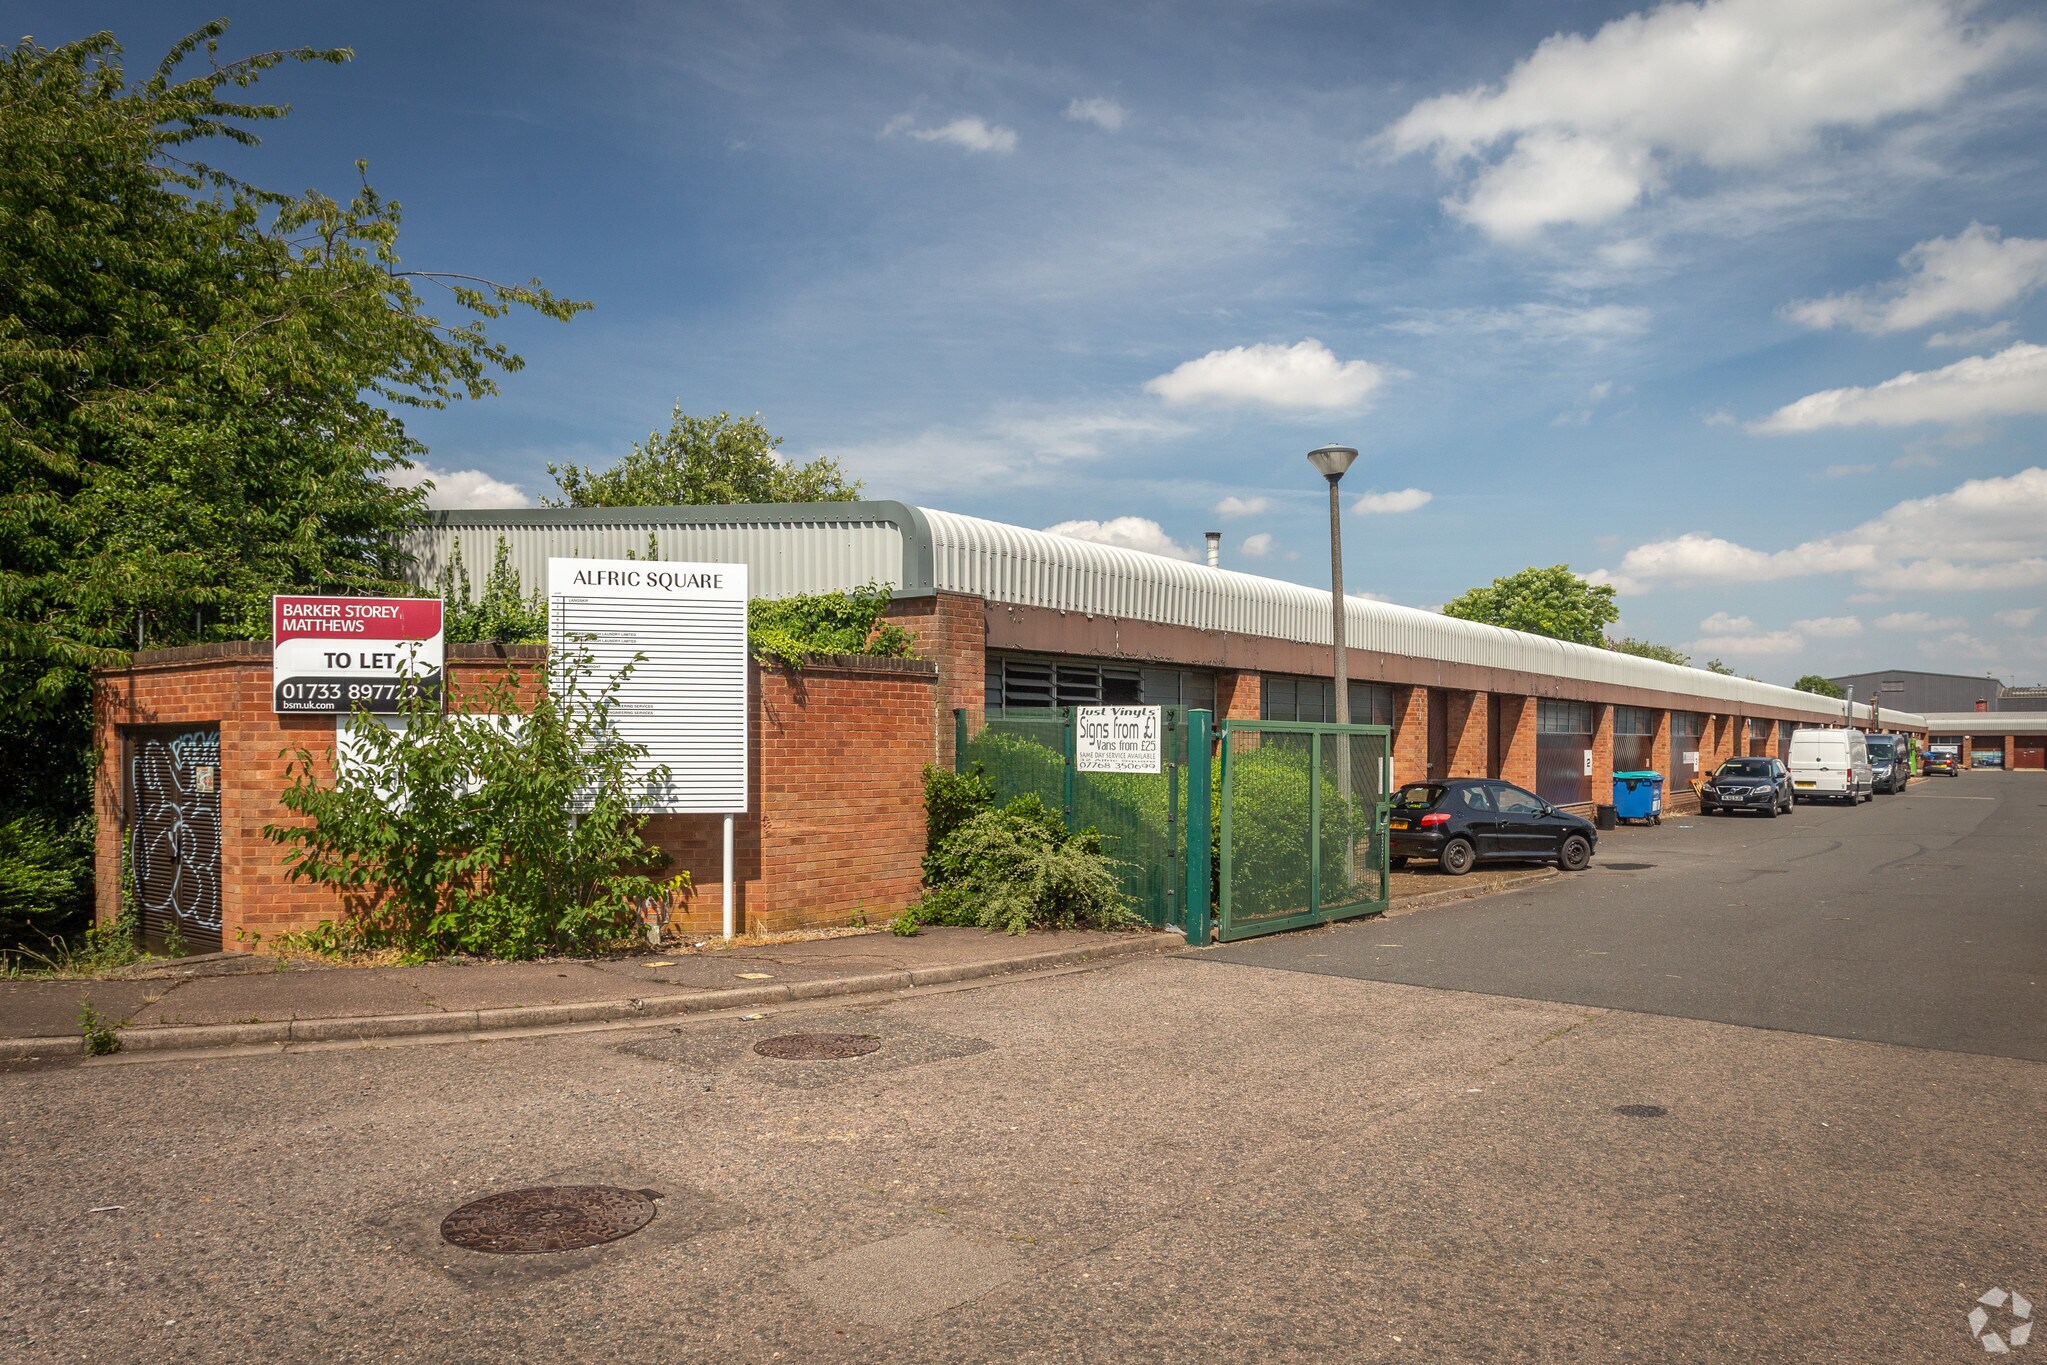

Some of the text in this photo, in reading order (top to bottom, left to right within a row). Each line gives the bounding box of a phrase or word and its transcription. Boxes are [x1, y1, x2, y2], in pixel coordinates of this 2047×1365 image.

[573, 570, 723, 591] ALFRIC SQUARE
[283, 604, 399, 618] BARKER STOREY
[282, 619, 364, 632] MATTHEWS
[324, 652, 395, 669] TO LET
[282, 683, 341, 699] 01733
[283, 700, 335, 710] bsm.uk.com
[1080, 708, 1155, 718] Just Vinyls
[1080, 716, 1156, 746] Signs from £1
[1096, 739, 1156, 752] Vans from £25
[1079, 751, 1094, 759] SAME
[1127, 752, 1156, 760] AVAILABLE
